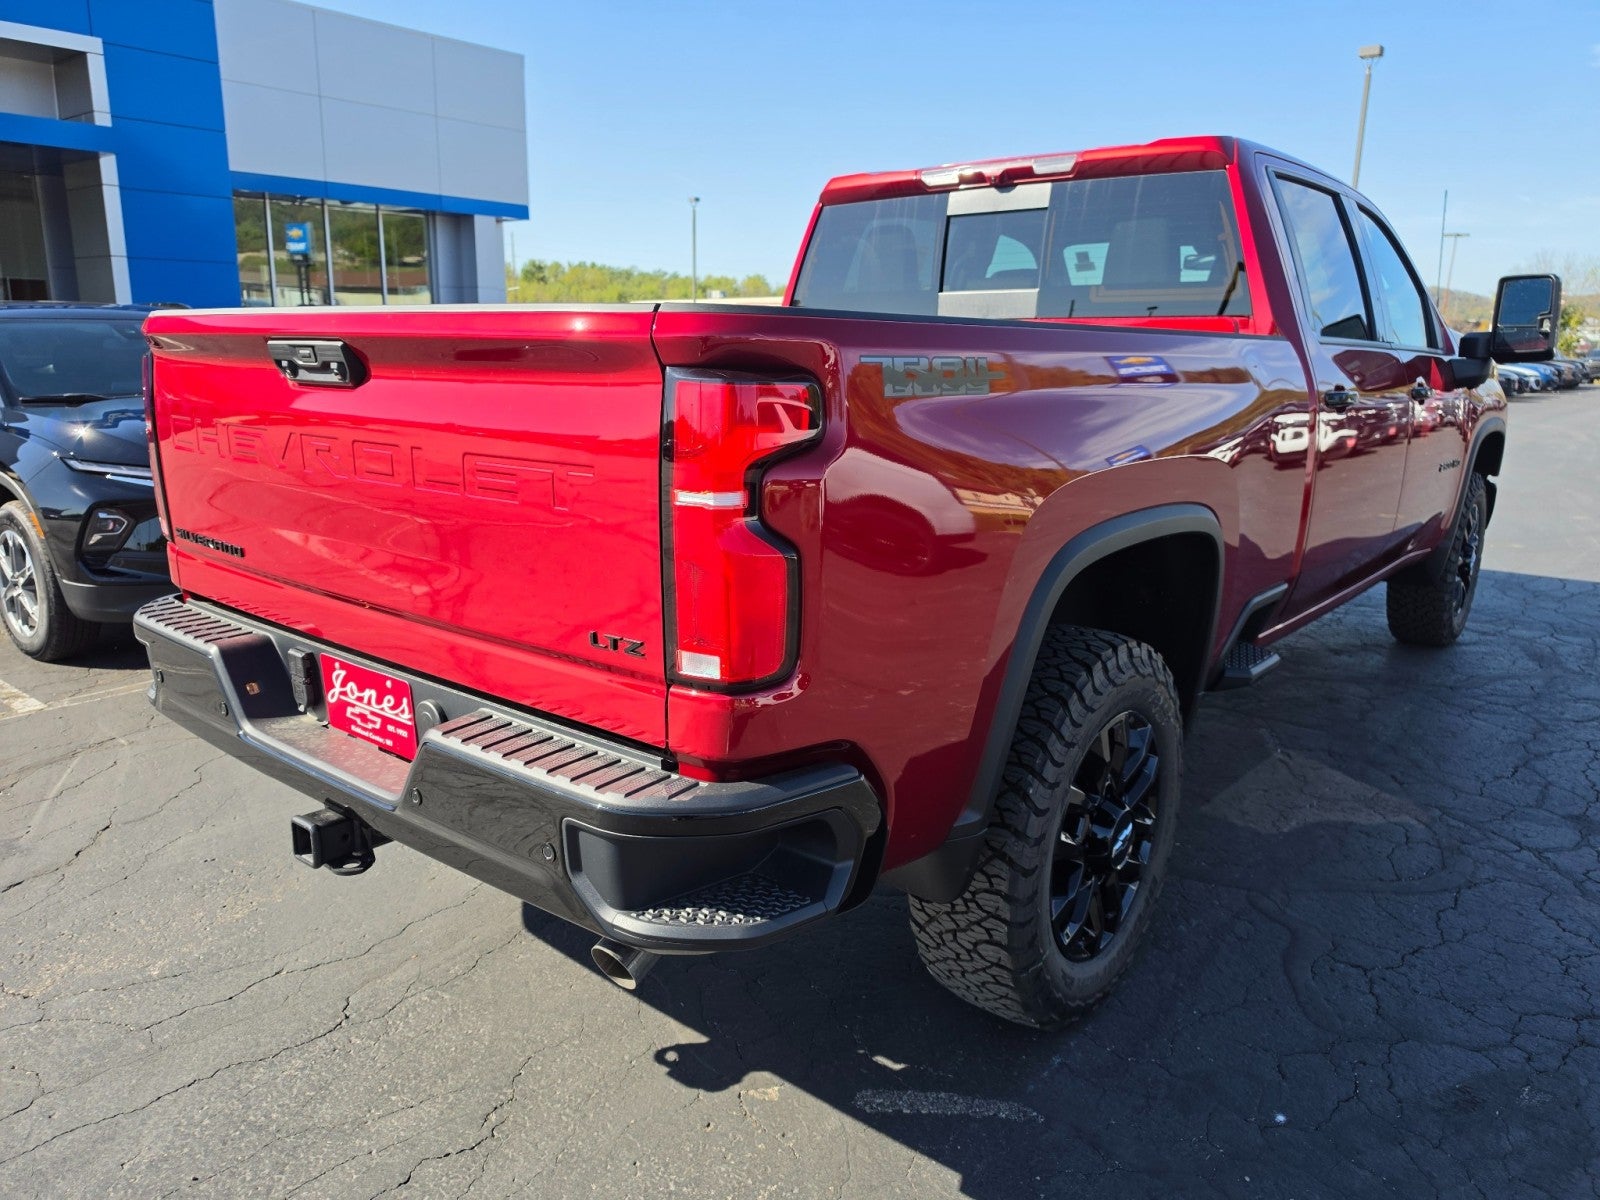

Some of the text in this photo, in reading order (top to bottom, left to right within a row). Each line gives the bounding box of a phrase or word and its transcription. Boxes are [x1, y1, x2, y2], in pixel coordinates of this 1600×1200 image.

[860, 354, 1005, 380] TRAIL
[169, 415, 595, 511] CHEVROLET
[589, 630, 647, 658] LTZ
[327, 669, 412, 719] Jones
